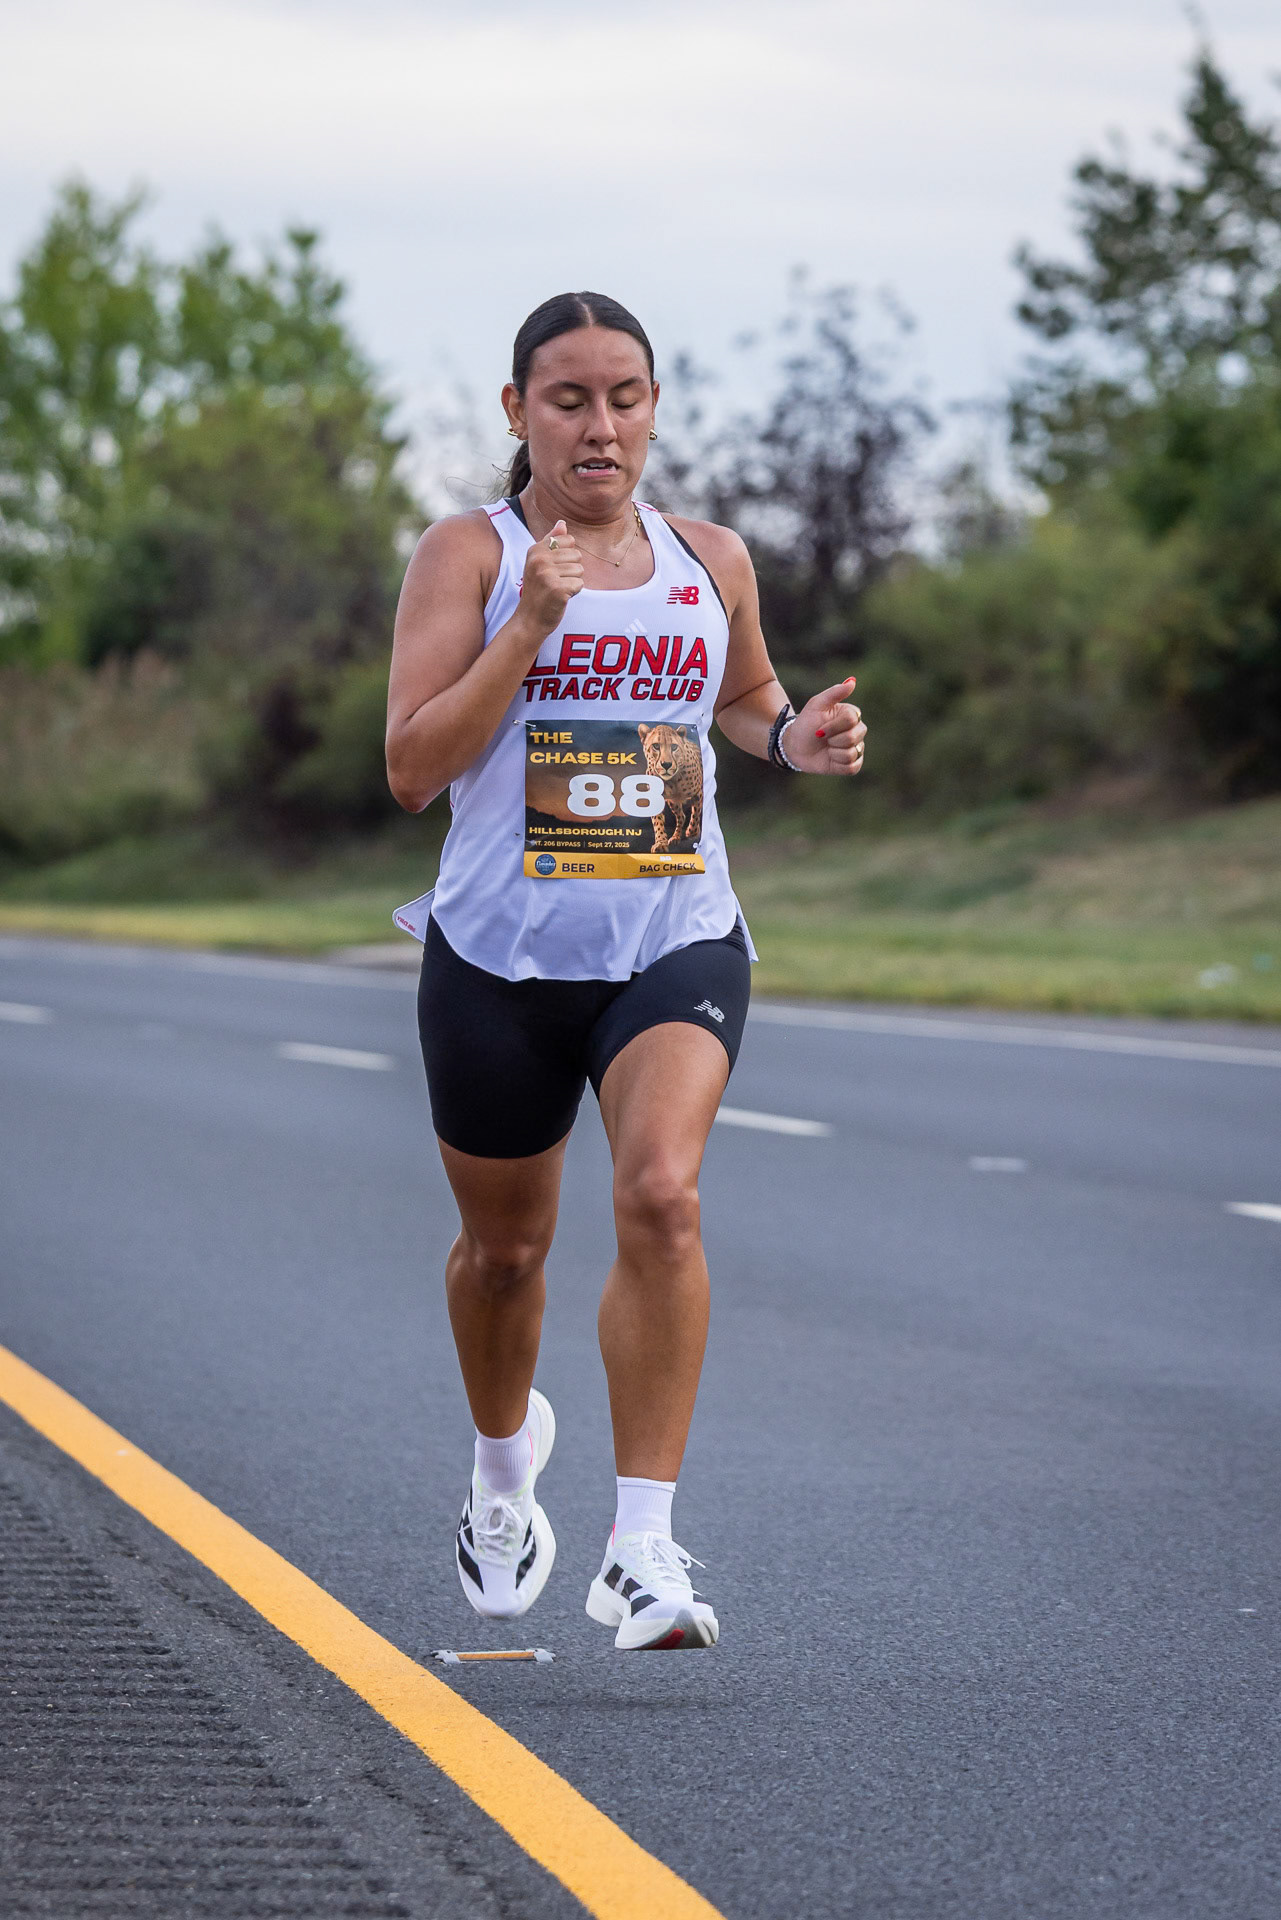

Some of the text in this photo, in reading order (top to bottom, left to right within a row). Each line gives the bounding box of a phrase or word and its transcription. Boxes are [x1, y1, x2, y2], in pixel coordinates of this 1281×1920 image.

[522, 676, 705, 703] TRACK CLUB
[529, 731, 574, 744] THE
[529, 751, 638, 765] CHASE 5K
[566, 773, 666, 818] 88
[626, 828, 642, 836] NJ
[562, 862, 595, 873] BEER
[639, 862, 697, 873] BAG CHECK
